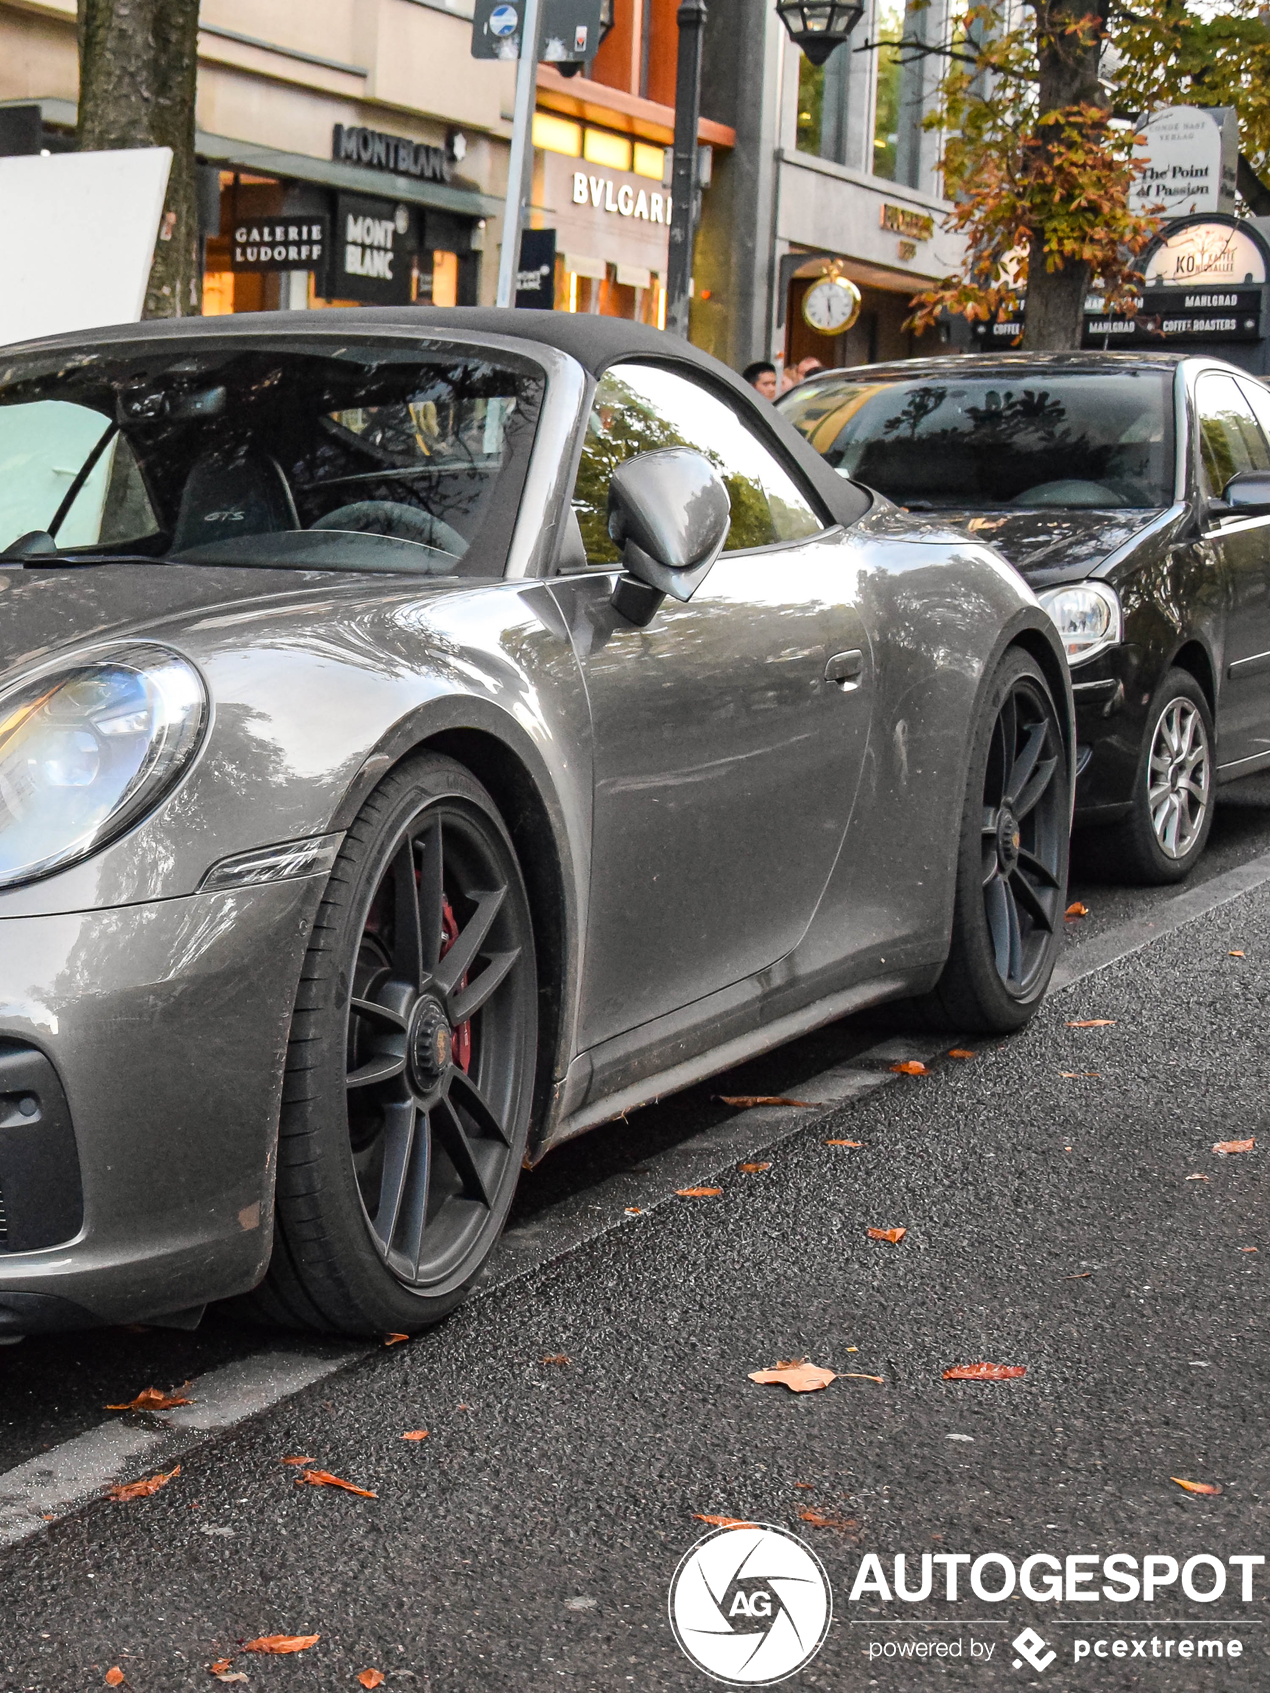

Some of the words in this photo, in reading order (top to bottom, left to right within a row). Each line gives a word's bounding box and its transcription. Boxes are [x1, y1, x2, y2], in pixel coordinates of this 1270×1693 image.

[1142, 166, 1168, 181] The
[1172, 164, 1209, 179] Point
[1155, 182, 1210, 198] Passion
[572, 172, 673, 226] BVLGARI
[235, 225, 322, 243] GALERIE
[346, 213, 395, 249] MONT
[235, 244, 322, 262] LUDORFF
[345, 243, 394, 281] BLANC
[1185, 294, 1238, 308] MAHLGRAD
[993, 323, 1020, 336] COFFEE
[1088, 321, 1136, 334] MAHLGRAD
[1163, 320, 1192, 333] COFFEE
[1193, 318, 1237, 332] ROASTERS
[204, 511, 245, 522] GTS
